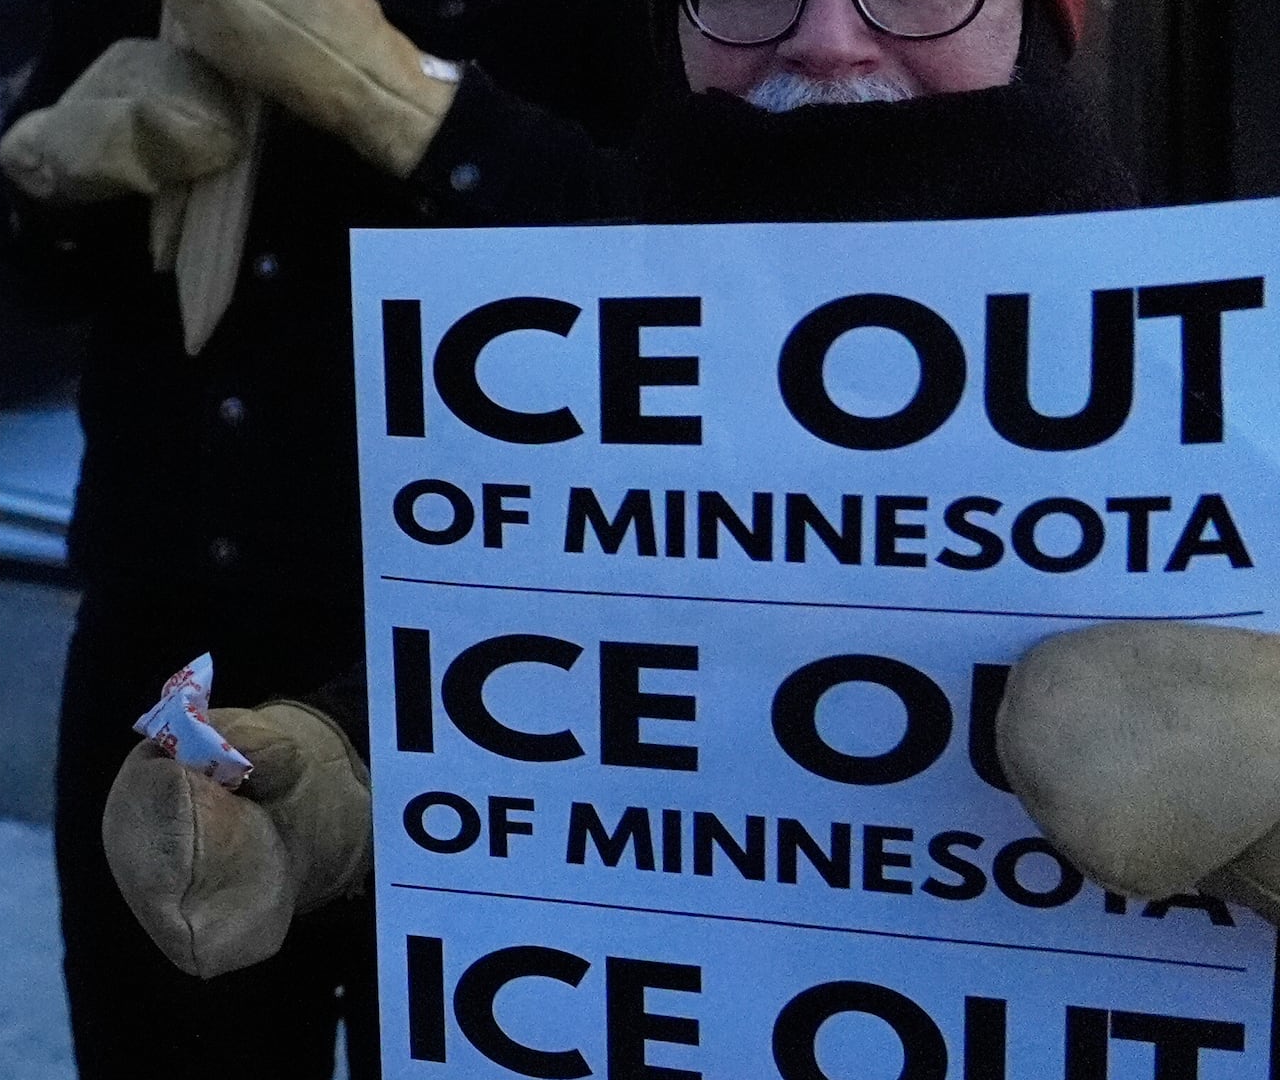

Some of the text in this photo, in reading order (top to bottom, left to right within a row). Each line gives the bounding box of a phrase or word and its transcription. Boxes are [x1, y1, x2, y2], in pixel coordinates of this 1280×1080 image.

[381, 276, 1266, 451] ICE OUT
[392, 478, 1254, 574] OF MINNESOTA
[392, 626, 699, 772] ICE
[402, 790, 1237, 927] OF MINNESO
[406, 934, 704, 1080] ICE
